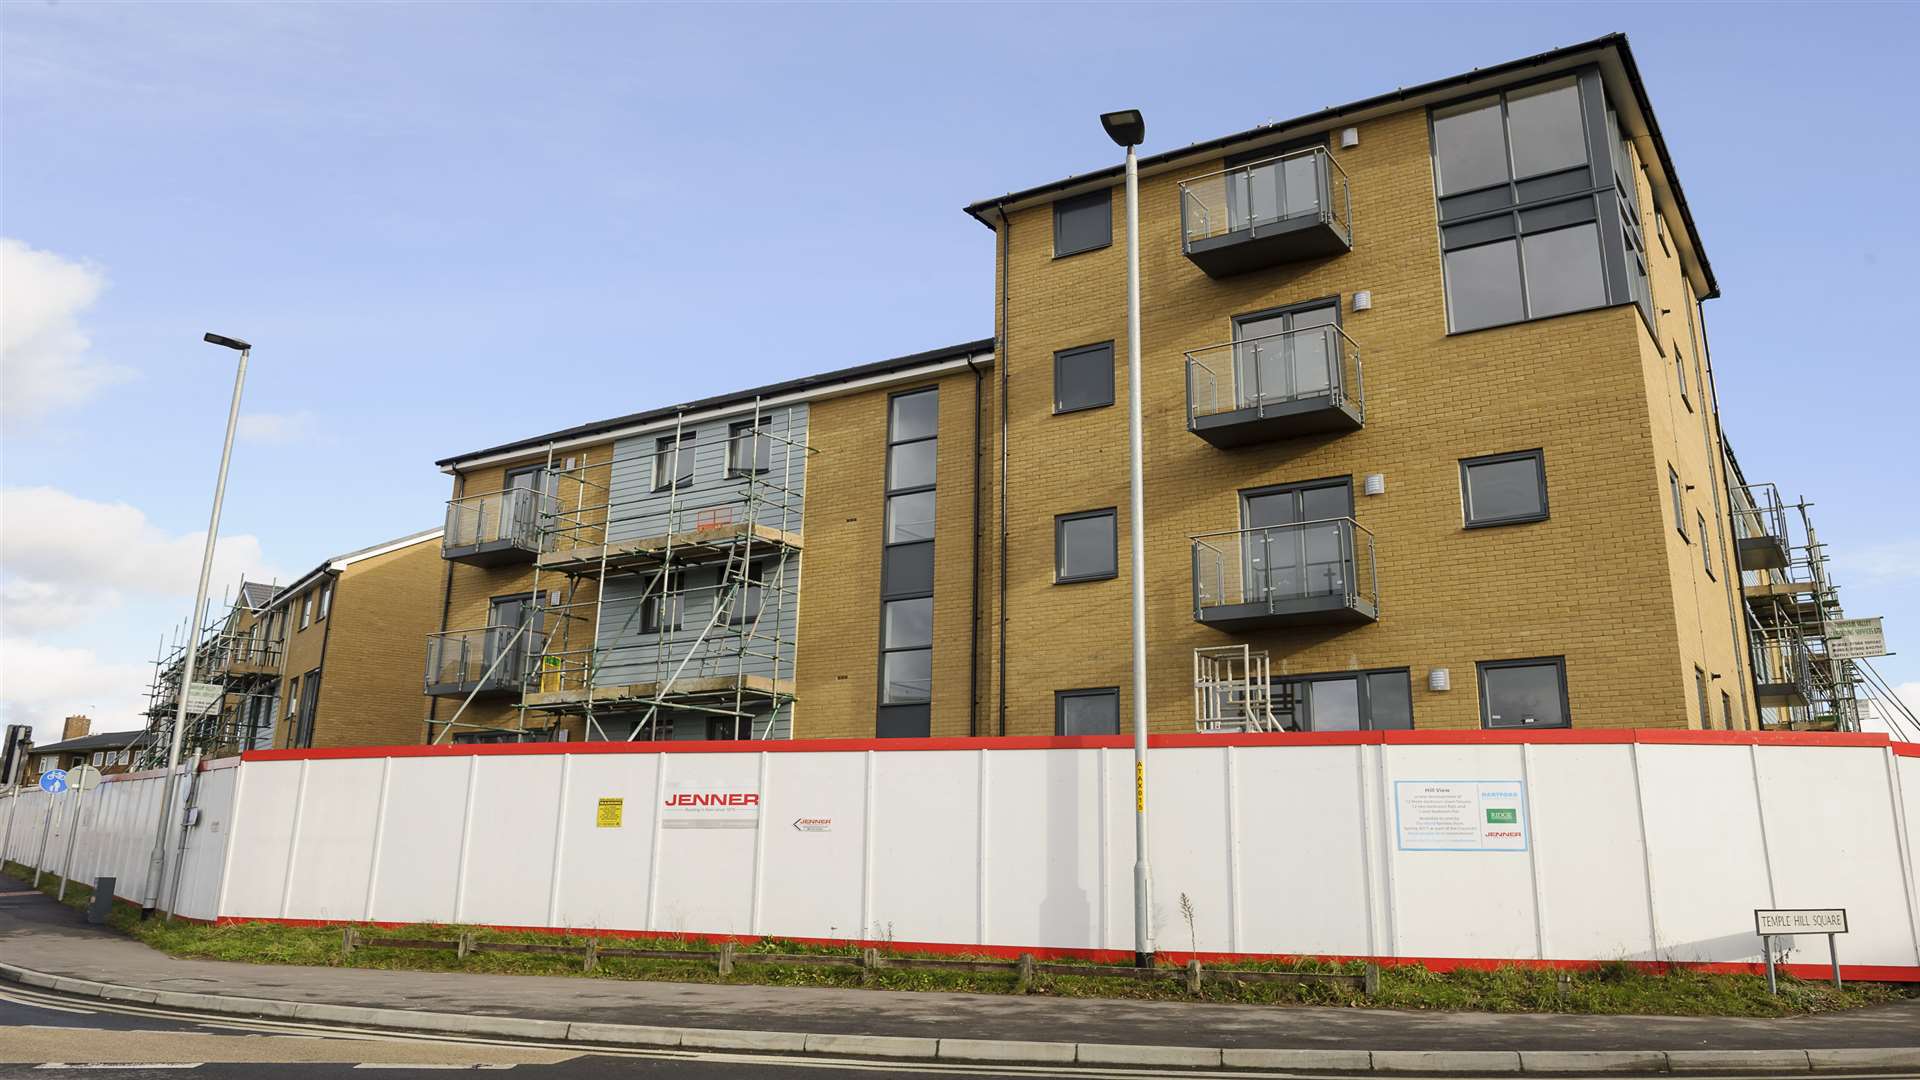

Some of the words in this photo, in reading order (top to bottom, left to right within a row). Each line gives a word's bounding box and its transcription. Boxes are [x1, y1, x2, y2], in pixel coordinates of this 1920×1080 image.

[664, 794, 759, 806] JENNER
[1761, 916, 1791, 927] TEMPLE
[1794, 915, 1811, 926] HILL
[1813, 914, 1842, 926] SQUARE
